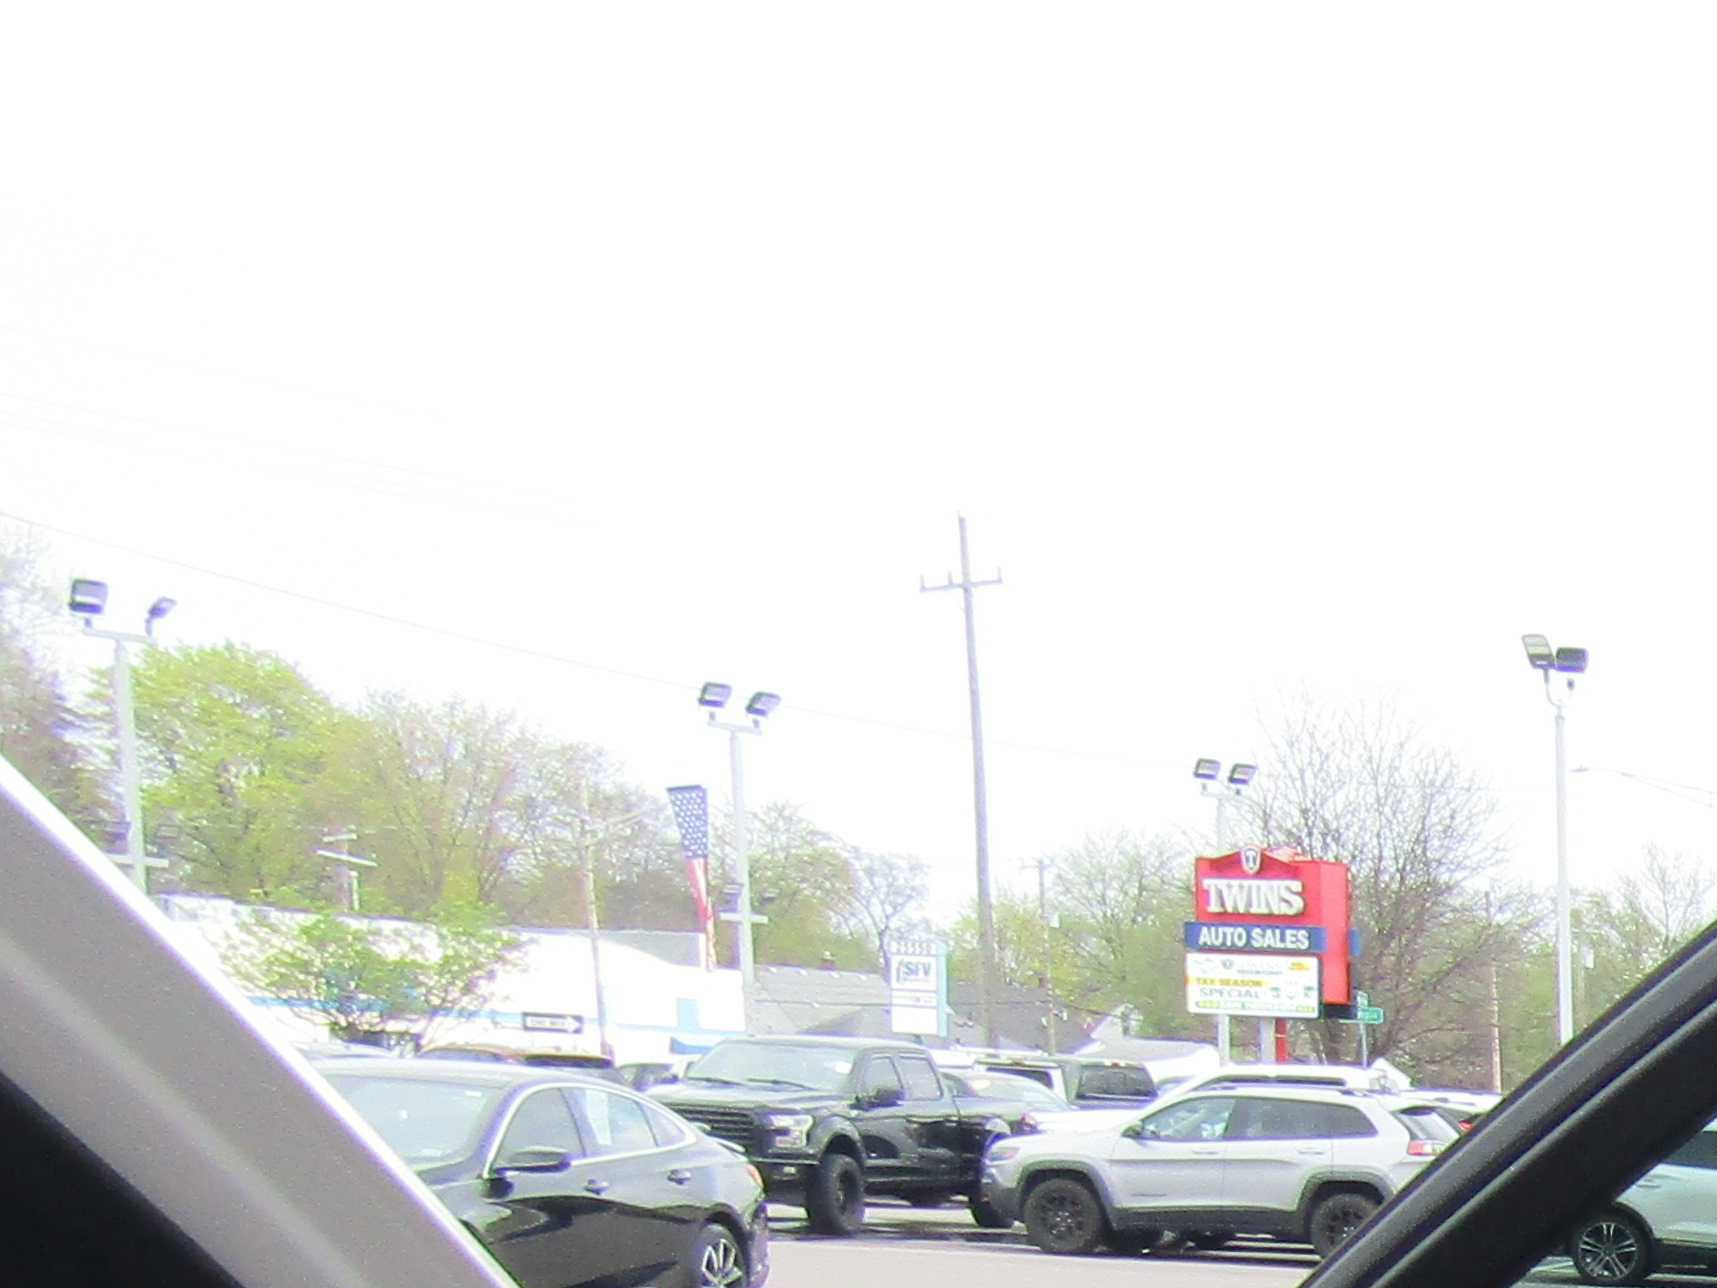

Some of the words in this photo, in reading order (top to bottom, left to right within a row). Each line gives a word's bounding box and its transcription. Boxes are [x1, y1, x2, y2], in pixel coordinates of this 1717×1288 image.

[1203, 879, 1305, 916] TWINS
[1198, 926, 1247, 947] AUTO
[1250, 927, 1310, 950] SALES
[1219, 978, 1264, 987] SEASON
[1200, 987, 1260, 999] SPECIAL
